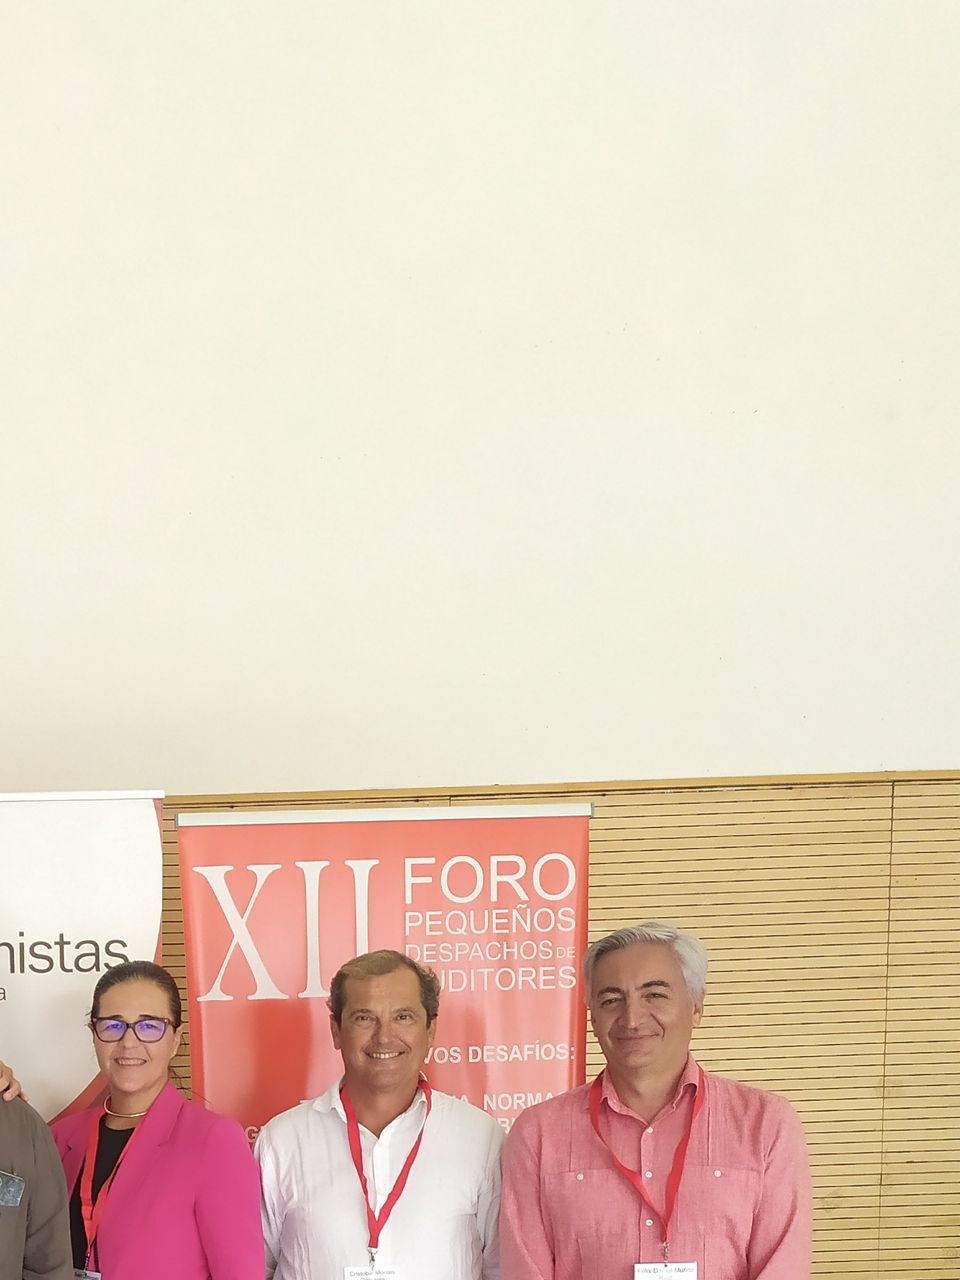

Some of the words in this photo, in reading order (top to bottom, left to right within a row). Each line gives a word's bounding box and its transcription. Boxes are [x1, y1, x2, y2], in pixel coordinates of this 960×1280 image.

[404, 852, 577, 905] FORO
[192, 859, 380, 1001] XII
[405, 903, 576, 936] PEQUEÑOS
[405, 940, 553, 963] DESPACHOS
[556, 947, 576, 959] DE
[440, 966, 577, 992] DITORES
[424, 1046, 462, 1064] VOS
[468, 1040, 576, 1063] DESAFÍOS:
